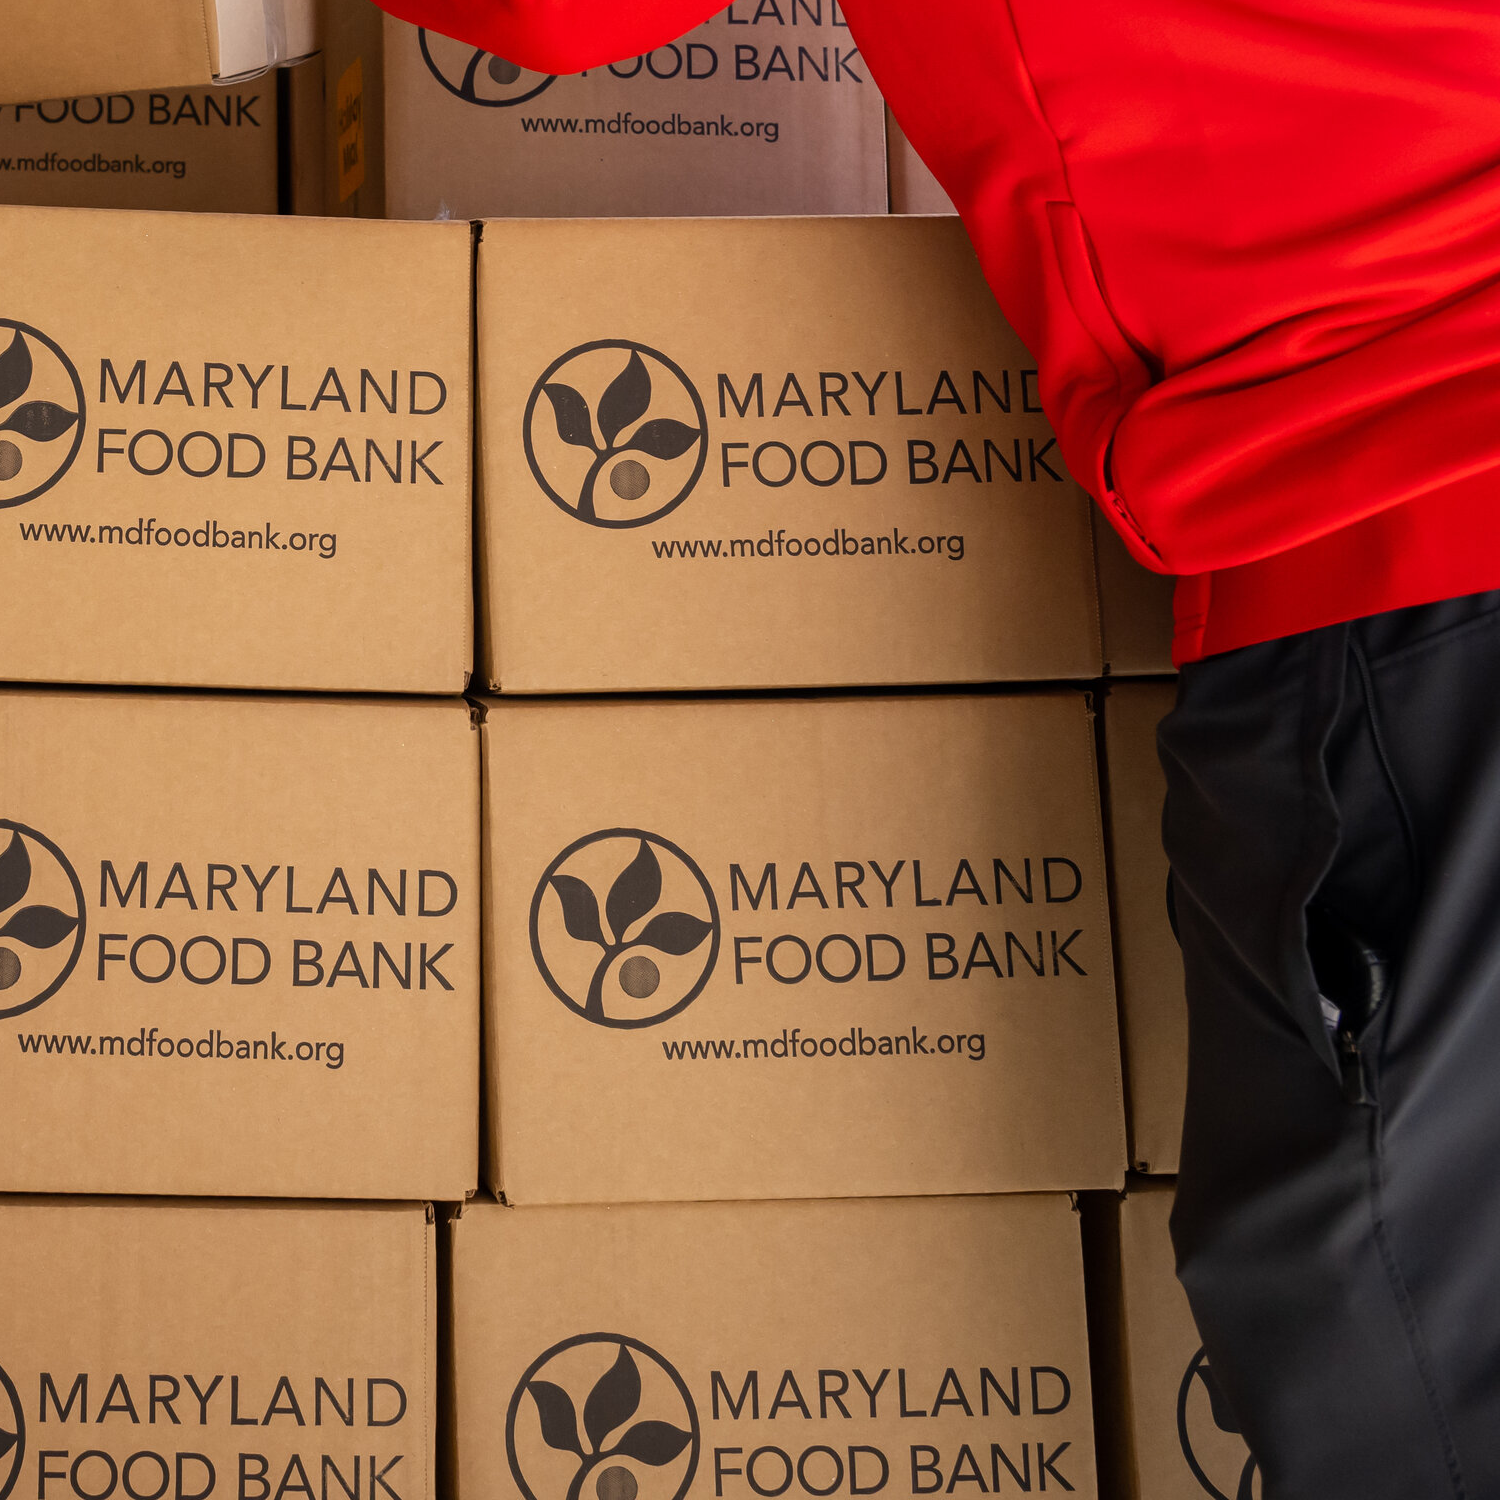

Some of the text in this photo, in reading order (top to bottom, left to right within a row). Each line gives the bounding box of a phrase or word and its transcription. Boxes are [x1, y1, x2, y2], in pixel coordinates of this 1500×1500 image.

[581, 43, 863, 84] OOD BANK
[149, 94, 260, 126] BANK
[521, 112, 778, 143] www.mdfoodbank.org
[100, 359, 446, 415] MARYLAND
[97, 429, 444, 485] FOOD BANK
[722, 438, 1064, 487] FOOD BANK
[20, 518, 336, 559] www.mdfoodbank.org
[652, 528, 965, 560] www.mdfoodbank.org
[100, 860, 457, 916] MARYLAND
[730, 856, 1082, 911] MARYLAND
[98, 934, 454, 990] FOOD BANK
[734, 929, 1088, 984] FOOD BANK
[18, 1028, 343, 1069] www.mdfoodbank.org
[662, 1026, 986, 1061] www.mdfoodbank.org
[39, 1373, 407, 1426] MARYLAND
[711, 1366, 1071, 1419] MARYLAND
[38, 1450, 404, 1500] FOOD BANK
[714, 1442, 1075, 1497] FOOD BANK
